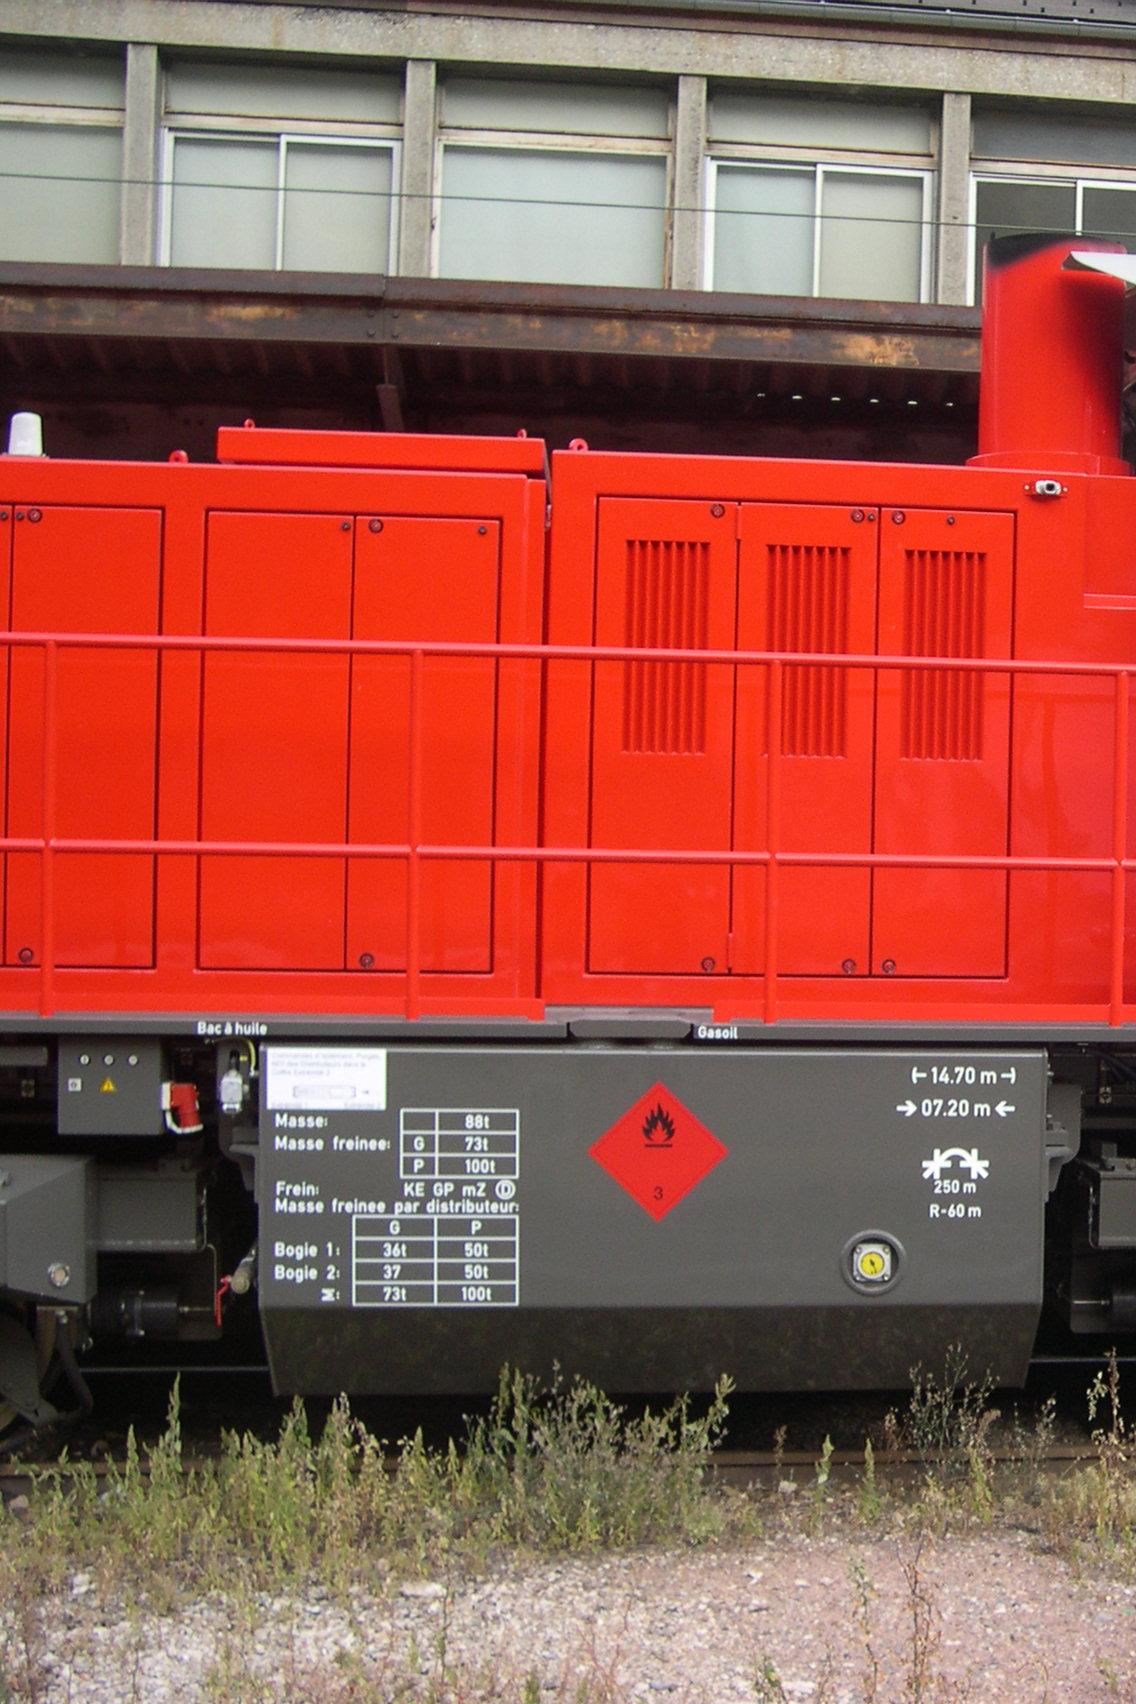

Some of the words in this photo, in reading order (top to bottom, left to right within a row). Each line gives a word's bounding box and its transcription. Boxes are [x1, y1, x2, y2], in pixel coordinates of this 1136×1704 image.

[197, 1020, 221, 1035] Bac
[235, 1020, 268, 1036] huile
[697, 1025, 738, 1039] Gasoil
[931, 1066, 976, 1085] 14.70
[980, 1071, 997, 1085] m
[921, 1099, 970, 1117] 07.20
[973, 1103, 991, 1117] m
[275, 1113, 328, 1128] Masse:
[464, 1114, 490, 1129] 88t
[275, 1135, 324, 1150] Masse
[413, 1136, 426, 1151] G
[464, 1136, 488, 1151] 73t
[413, 1158, 425, 1173] P
[465, 1158, 496, 1174] 100t
[276, 1181, 320, 1196] Frein:
[403, 1182, 426, 1197] KE
[433, 1182, 455, 1197] GP
[462, 1182, 487, 1197] mZ
[654, 1186, 664, 1200] 3
[933, 1180, 960, 1194] 250
[963, 1183, 977, 1194] m
[275, 1199, 324, 1213] Masse
[394, 1200, 420, 1215] par
[426, 1198, 519, 1213] distributeur:
[929, 1204, 965, 1218] R-60
[967, 1206, 982, 1218] m
[389, 1220, 401, 1235] G
[471, 1220, 482, 1235] P
[274, 1242, 318, 1260] Bogie
[383, 1242, 407, 1257] 36t
[464, 1242, 489, 1257] 50t
[274, 1264, 318, 1282] Bogie
[383, 1265, 401, 1279] 37
[464, 1265, 489, 1279] 50t
[383, 1287, 407, 1301] 73t
[462, 1287, 492, 1301] 100t
